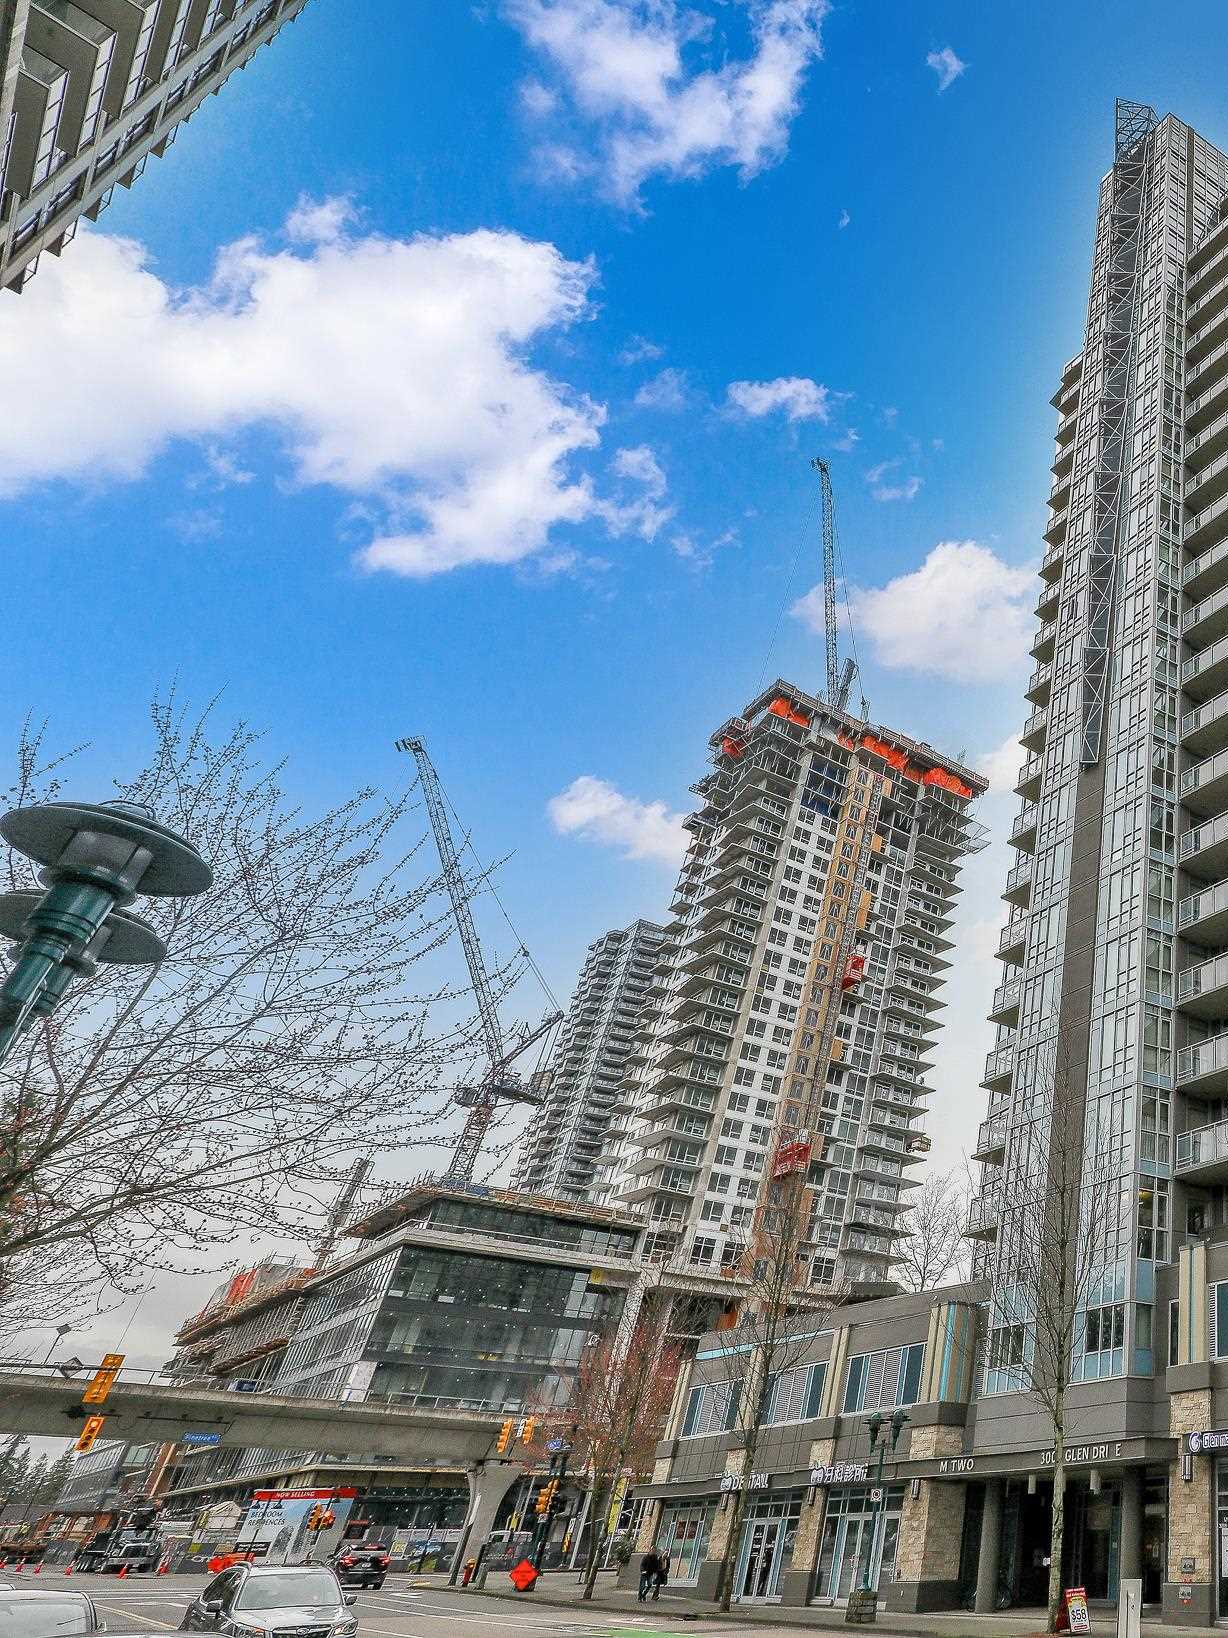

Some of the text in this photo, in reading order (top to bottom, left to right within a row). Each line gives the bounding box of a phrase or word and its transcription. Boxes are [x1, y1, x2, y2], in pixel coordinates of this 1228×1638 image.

[1202, 1432, 1219, 1448] Glen
[1064, 1446, 1089, 1462] GLEN
[951, 1458, 974, 1472] TWO
[1071, 1609, 1087, 1620] $58
